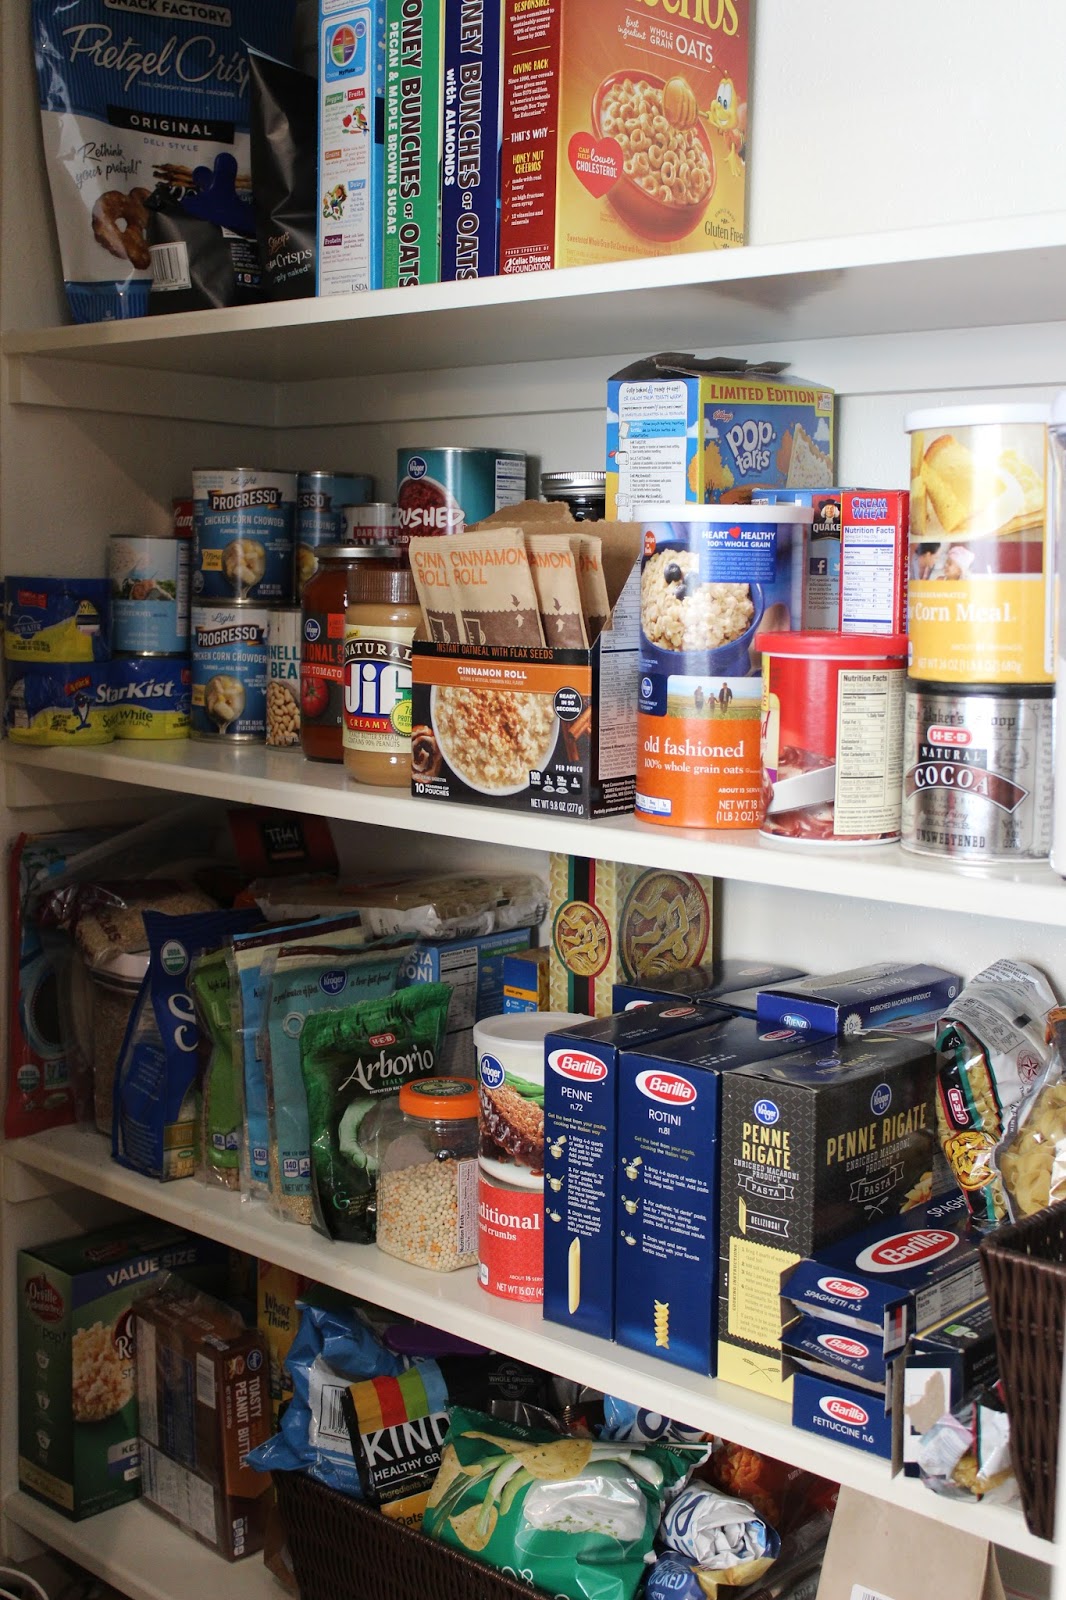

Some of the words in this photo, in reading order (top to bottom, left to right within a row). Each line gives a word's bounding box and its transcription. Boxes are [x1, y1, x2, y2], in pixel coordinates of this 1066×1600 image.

[162, 2, 227, 23] FACTORY
[626, 16, 639, 28] first
[650, 25, 674, 41] WHOLE
[389, 21, 399, 68] PECAN
[650, 36, 673, 50] GRAIN
[675, 34, 713, 64] OATS
[62, 23, 178, 92] Pretzel
[513, 61, 532, 74] GIVING
[533, 58, 549, 71] BACK
[388, 71, 399, 82] &
[446, 68, 457, 105] with
[387, 84, 399, 131] MAPLE
[130, 115, 212, 136] ORIGINAL
[457, 61, 483, 190] BUNCHES
[511, 130, 531, 143] THAT'S
[532, 126, 548, 140] WHY
[143, 137, 164, 147] DELI
[169, 143, 199, 152] STYLE
[399, 75, 422, 200] BUNCHES
[444, 107, 457, 186] ALMONDS
[78, 142, 125, 163] Rethink
[386, 134, 398, 186] BROWN
[513, 152, 531, 164] HONEY
[532, 150, 544, 161] NUT
[577, 152, 591, 160] HELP
[590, 148, 616, 166] lower
[515, 161, 542, 174] CHEERIOS
[576, 160, 617, 178] CHOLESTEROL
[461, 191, 472, 210] OF
[386, 188, 397, 235] SUGAR
[403, 203, 414, 218] OF
[704, 220, 729, 239] Gluten
[730, 227, 744, 244] Free
[512, 262, 551, 274] FOUNDATION
[351, 283, 368, 292] USDA
[710, 384, 766, 402] LIMITED
[767, 387, 815, 403] EDITION
[408, 459, 426, 476] Kroger
[736, 449, 771, 475] tarts
[212, 490, 277, 511] PROGRESSO
[851, 496, 888, 509] CREAM
[204, 515, 231, 526] CHICKEN
[232, 515, 252, 524] CORN
[253, 516, 285, 527] CHOWDER
[852, 507, 888, 520] WHEAT
[356, 527, 375, 538] DARK
[702, 531, 729, 540] HEART
[740, 531, 776, 540] HEALTHY
[844, 526, 875, 534] Nutrition
[450, 548, 527, 568] CINNAMON
[417, 569, 450, 587] ROLL
[453, 568, 488, 586] ROLL
[211, 612, 236, 624] Light
[915, 602, 950, 622] Corn
[956, 602, 1011, 622] Meal
[197, 626, 258, 646] PROGRESSO
[212, 652, 231, 661] CORN
[233, 652, 267, 664] CHOWDER
[345, 642, 412, 661] NATURAL
[436, 643, 460, 652] INSTANT
[461, 644, 489, 656] OATMEAL
[491, 647, 508, 657] WITH
[509, 648, 528, 659] FLAX
[529, 650, 554, 660] SEEDS
[312, 666, 343, 678] TOMATO
[457, 666, 502, 678] CINNAMON
[504, 669, 528, 680] ROLL
[843, 674, 871, 682] Nutrition
[872, 674, 888, 682] Facts
[95, 678, 175, 704] StarKist
[345, 663, 412, 715] Jif
[119, 709, 153, 723] White
[350, 718, 388, 730] CREAMY
[361, 733, 378, 741] BUTTER
[379, 733, 399, 741] SPREAD
[376, 740, 400, 748] PEANUTS
[644, 735, 660, 753] old
[664, 737, 744, 759] fashioned
[921, 746, 981, 762] NATURAL
[567, 765, 584, 773] POUCH
[644, 758, 662, 770] 100%
[664, 761, 691, 773] whole
[693, 762, 720, 775] grain
[723, 764, 744, 774] oats
[415, 782, 425, 794] 10
[914, 765, 989, 795] COCOA
[425, 788, 450, 797] POUCHES
[916, 829, 985, 848] UNSWEETENED
[323, 974, 346, 990] Kroger
[869, 1001, 892, 1013] ENRICHED
[891, 996, 912, 1008] MACARONI
[912, 991, 932, 1003] PRODUCT
[337, 1045, 435, 1092] Arborio
[481, 1060, 503, 1082] Kroger
[561, 1056, 603, 1076] Barilla
[561, 1086, 593, 1103] PENNE
[649, 1077, 691, 1099] Barilla
[569, 1103, 584, 1112] n.72
[757, 1105, 777, 1121] Kroger
[648, 1108, 682, 1127] ROTINI
[658, 1126, 671, 1136] n.81
[742, 1122, 791, 1150] PENNE
[826, 1122, 877, 1166] PENNE
[882, 1102, 927, 1144] RIGATE
[741, 1141, 791, 1170] RIGATE
[846, 1152, 879, 1172] ENRICHED
[879, 1137, 911, 1159] MACARONI
[733, 1158, 765, 1172] ENRICHED
[766, 1165, 800, 1181] MACARONI
[865, 1156, 894, 1175] PRODUCT
[752, 1171, 781, 1184] PRODUCT
[863, 1177, 891, 1197] PASTA
[751, 1184, 780, 1198] PASTA
[750, 1215, 781, 1231] DELIZIOSA!
[487, 1228, 517, 1241] crumbs
[877, 1230, 949, 1264] Barilla
[106, 1257, 160, 1287] VALUE
[162, 1248, 197, 1268] SIZE
[827, 1280, 865, 1297] Barilla
[264, 1291, 291, 1320] Wheat
[803, 1289, 848, 1308] SPAGHETTI
[848, 1301, 862, 1312] n.5
[264, 1310, 290, 1332] Thins
[800, 1339, 851, 1367] FETTUCCINE
[851, 1362, 865, 1371] n.6
[827, 1339, 865, 1356] Barilla
[235, 1380, 249, 1422] PEANUT
[249, 1375, 262, 1418] TOASTY
[830, 1401, 865, 1422] Barilla
[812, 1415, 860, 1439] FETTUCCINE
[862, 1431, 874, 1443] n.6
[237, 1424, 251, 1470] BUTTER
[360, 1413, 451, 1467] KIND
[373, 1457, 423, 1483] HEALTHY
[379, 1478, 422, 1500] ingredients
[398, 1511, 424, 1526] Oats
